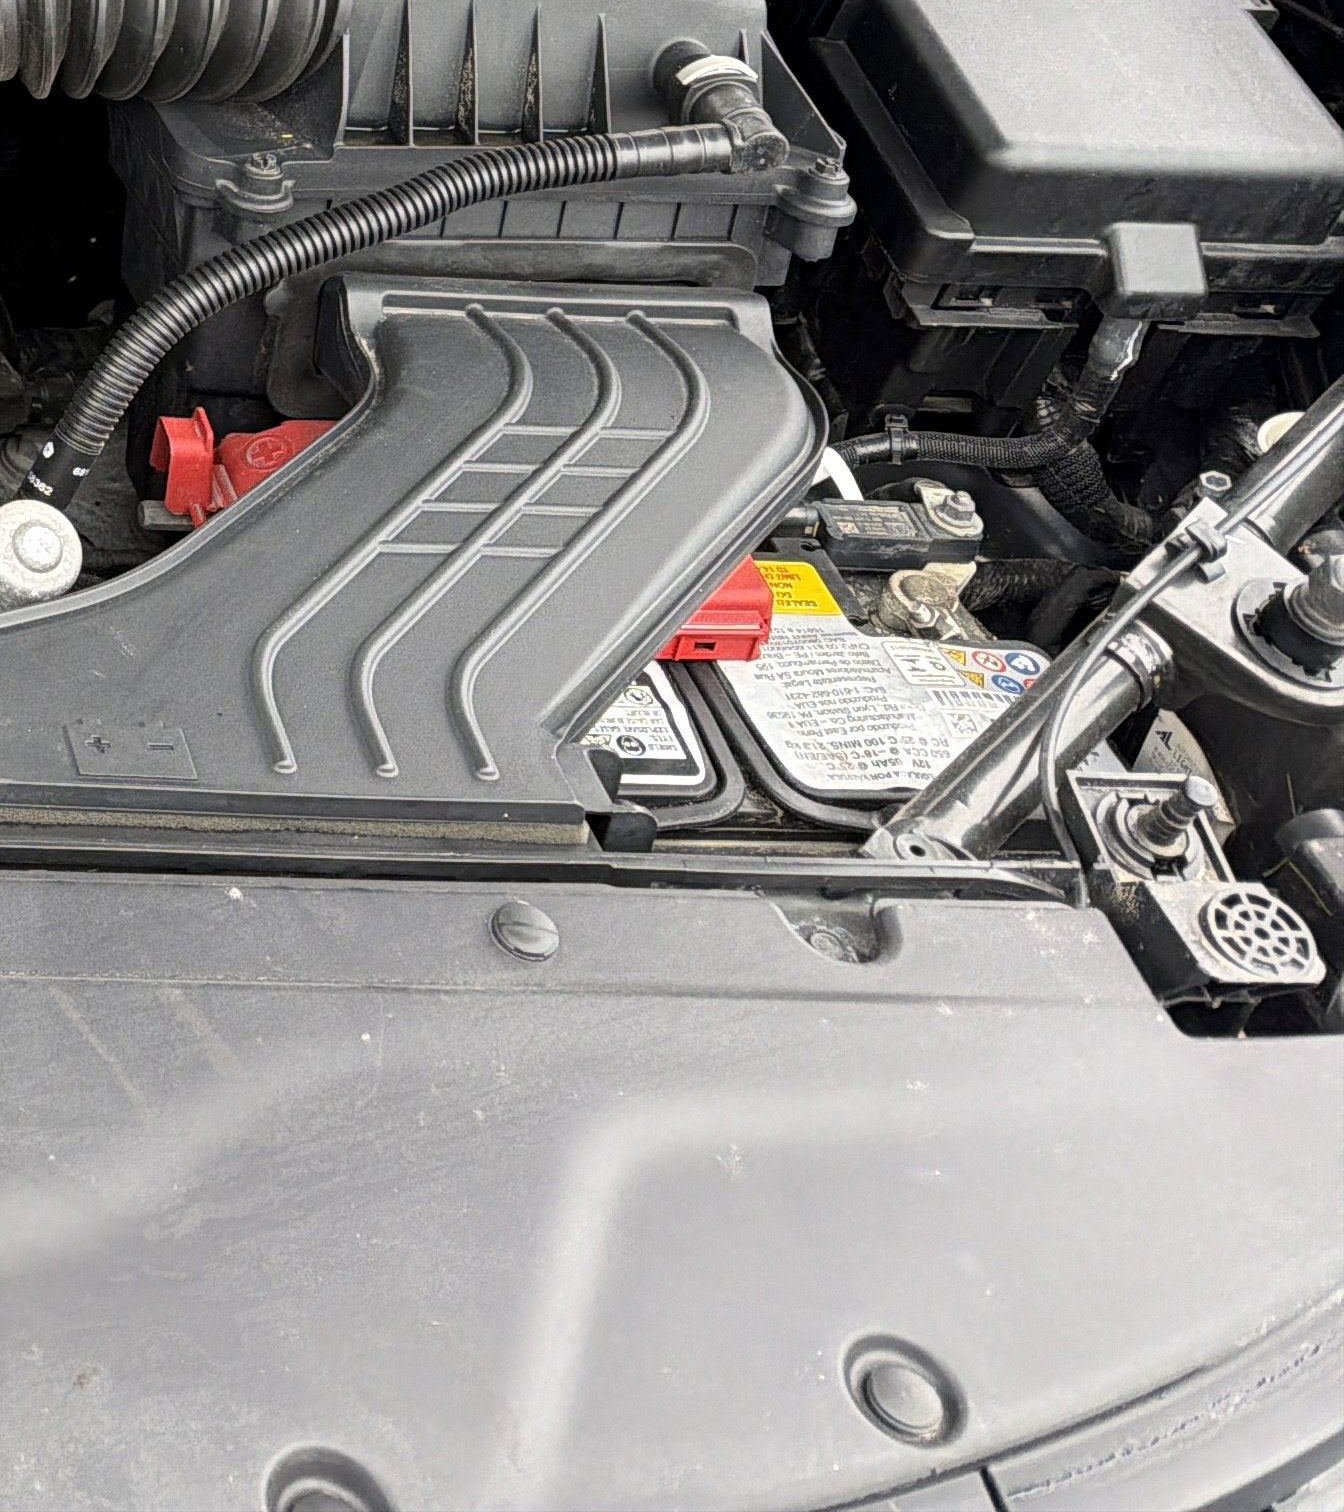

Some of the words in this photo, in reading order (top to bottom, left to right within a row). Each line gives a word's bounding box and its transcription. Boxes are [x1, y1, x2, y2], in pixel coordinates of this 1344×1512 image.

[824, 727, 848, 736] East
[849, 724, 865, 733] por
[863, 737, 886, 747] 100
[932, 736, 950, 747] RC
[903, 748, 929, 758] CCA
[930, 750, 951, 758] 650
[912, 759, 932, 769] 12V
[870, 771, 891, 781] POR
